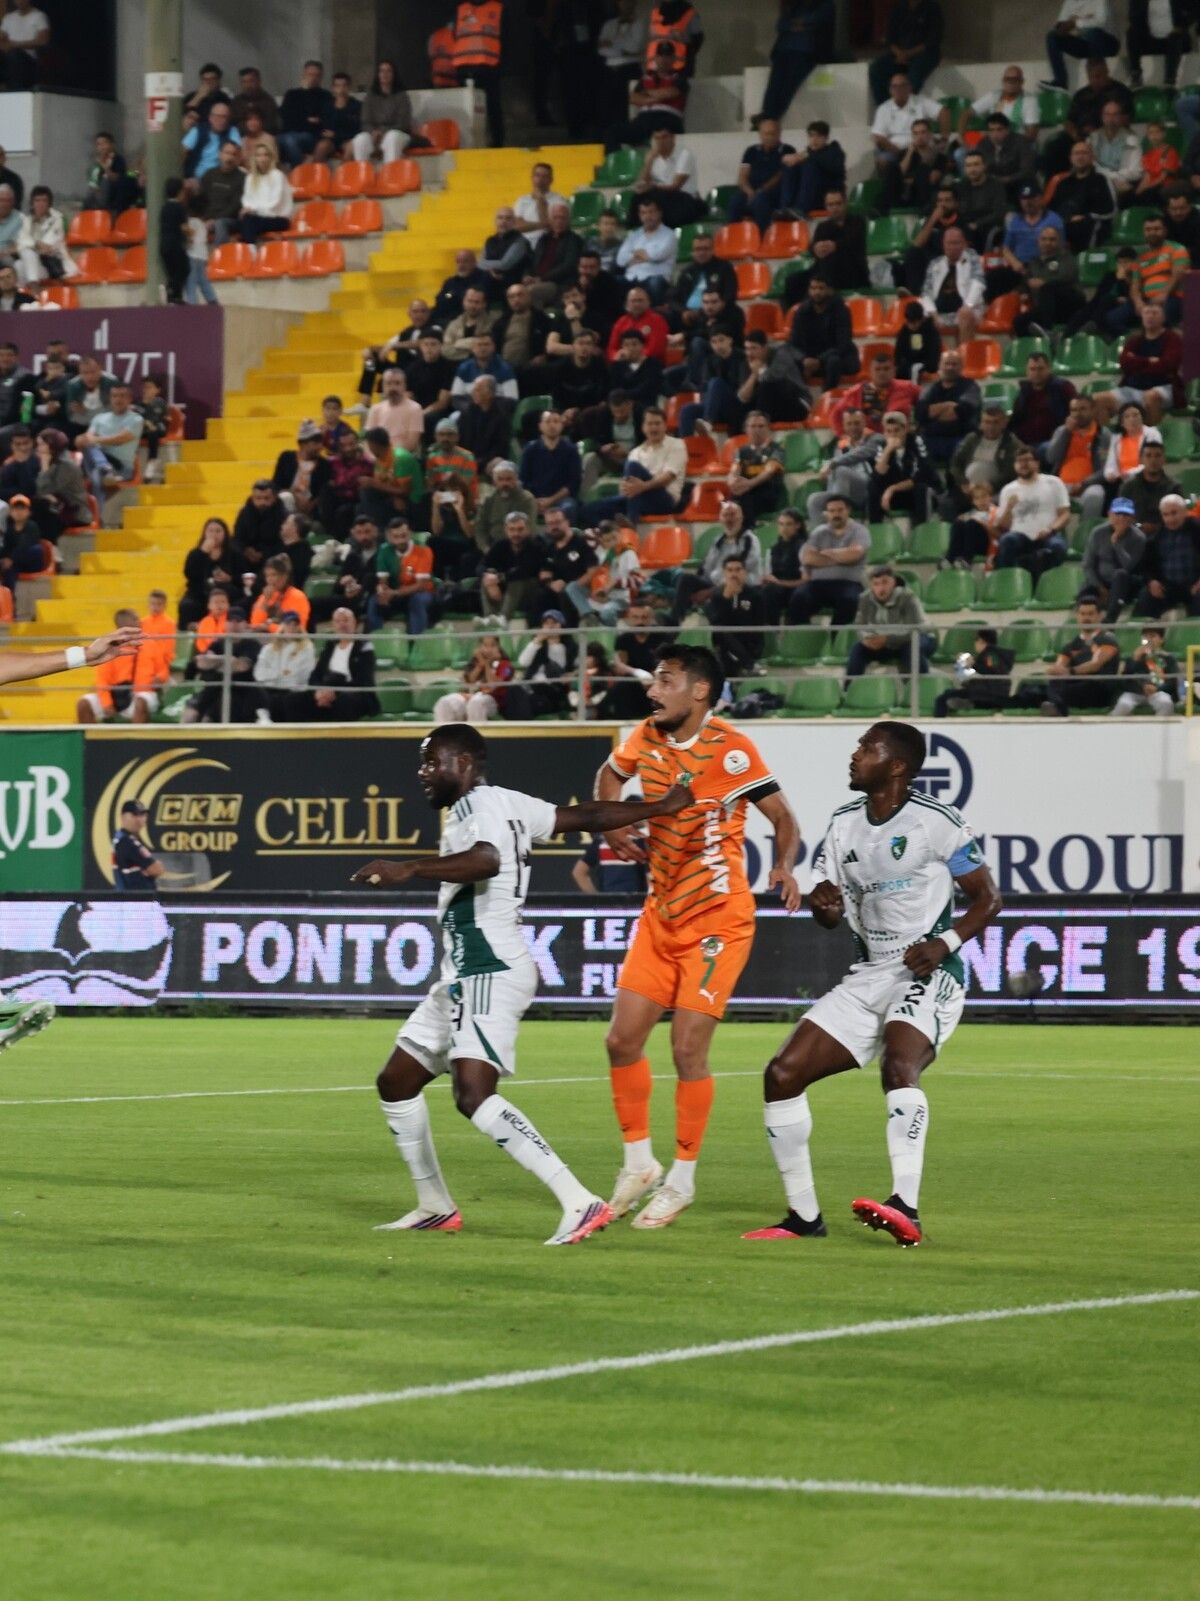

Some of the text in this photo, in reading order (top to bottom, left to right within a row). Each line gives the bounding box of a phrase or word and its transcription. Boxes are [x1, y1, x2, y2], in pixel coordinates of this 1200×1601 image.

[148, 97, 167, 120] F
[159, 798, 240, 823] CKM
[255, 784, 420, 846] CELİL
[160, 831, 238, 852] GROUP
[972, 834, 1184, 893] ROU
[700, 957, 716, 989] 7
[904, 983, 926, 1006] 2
